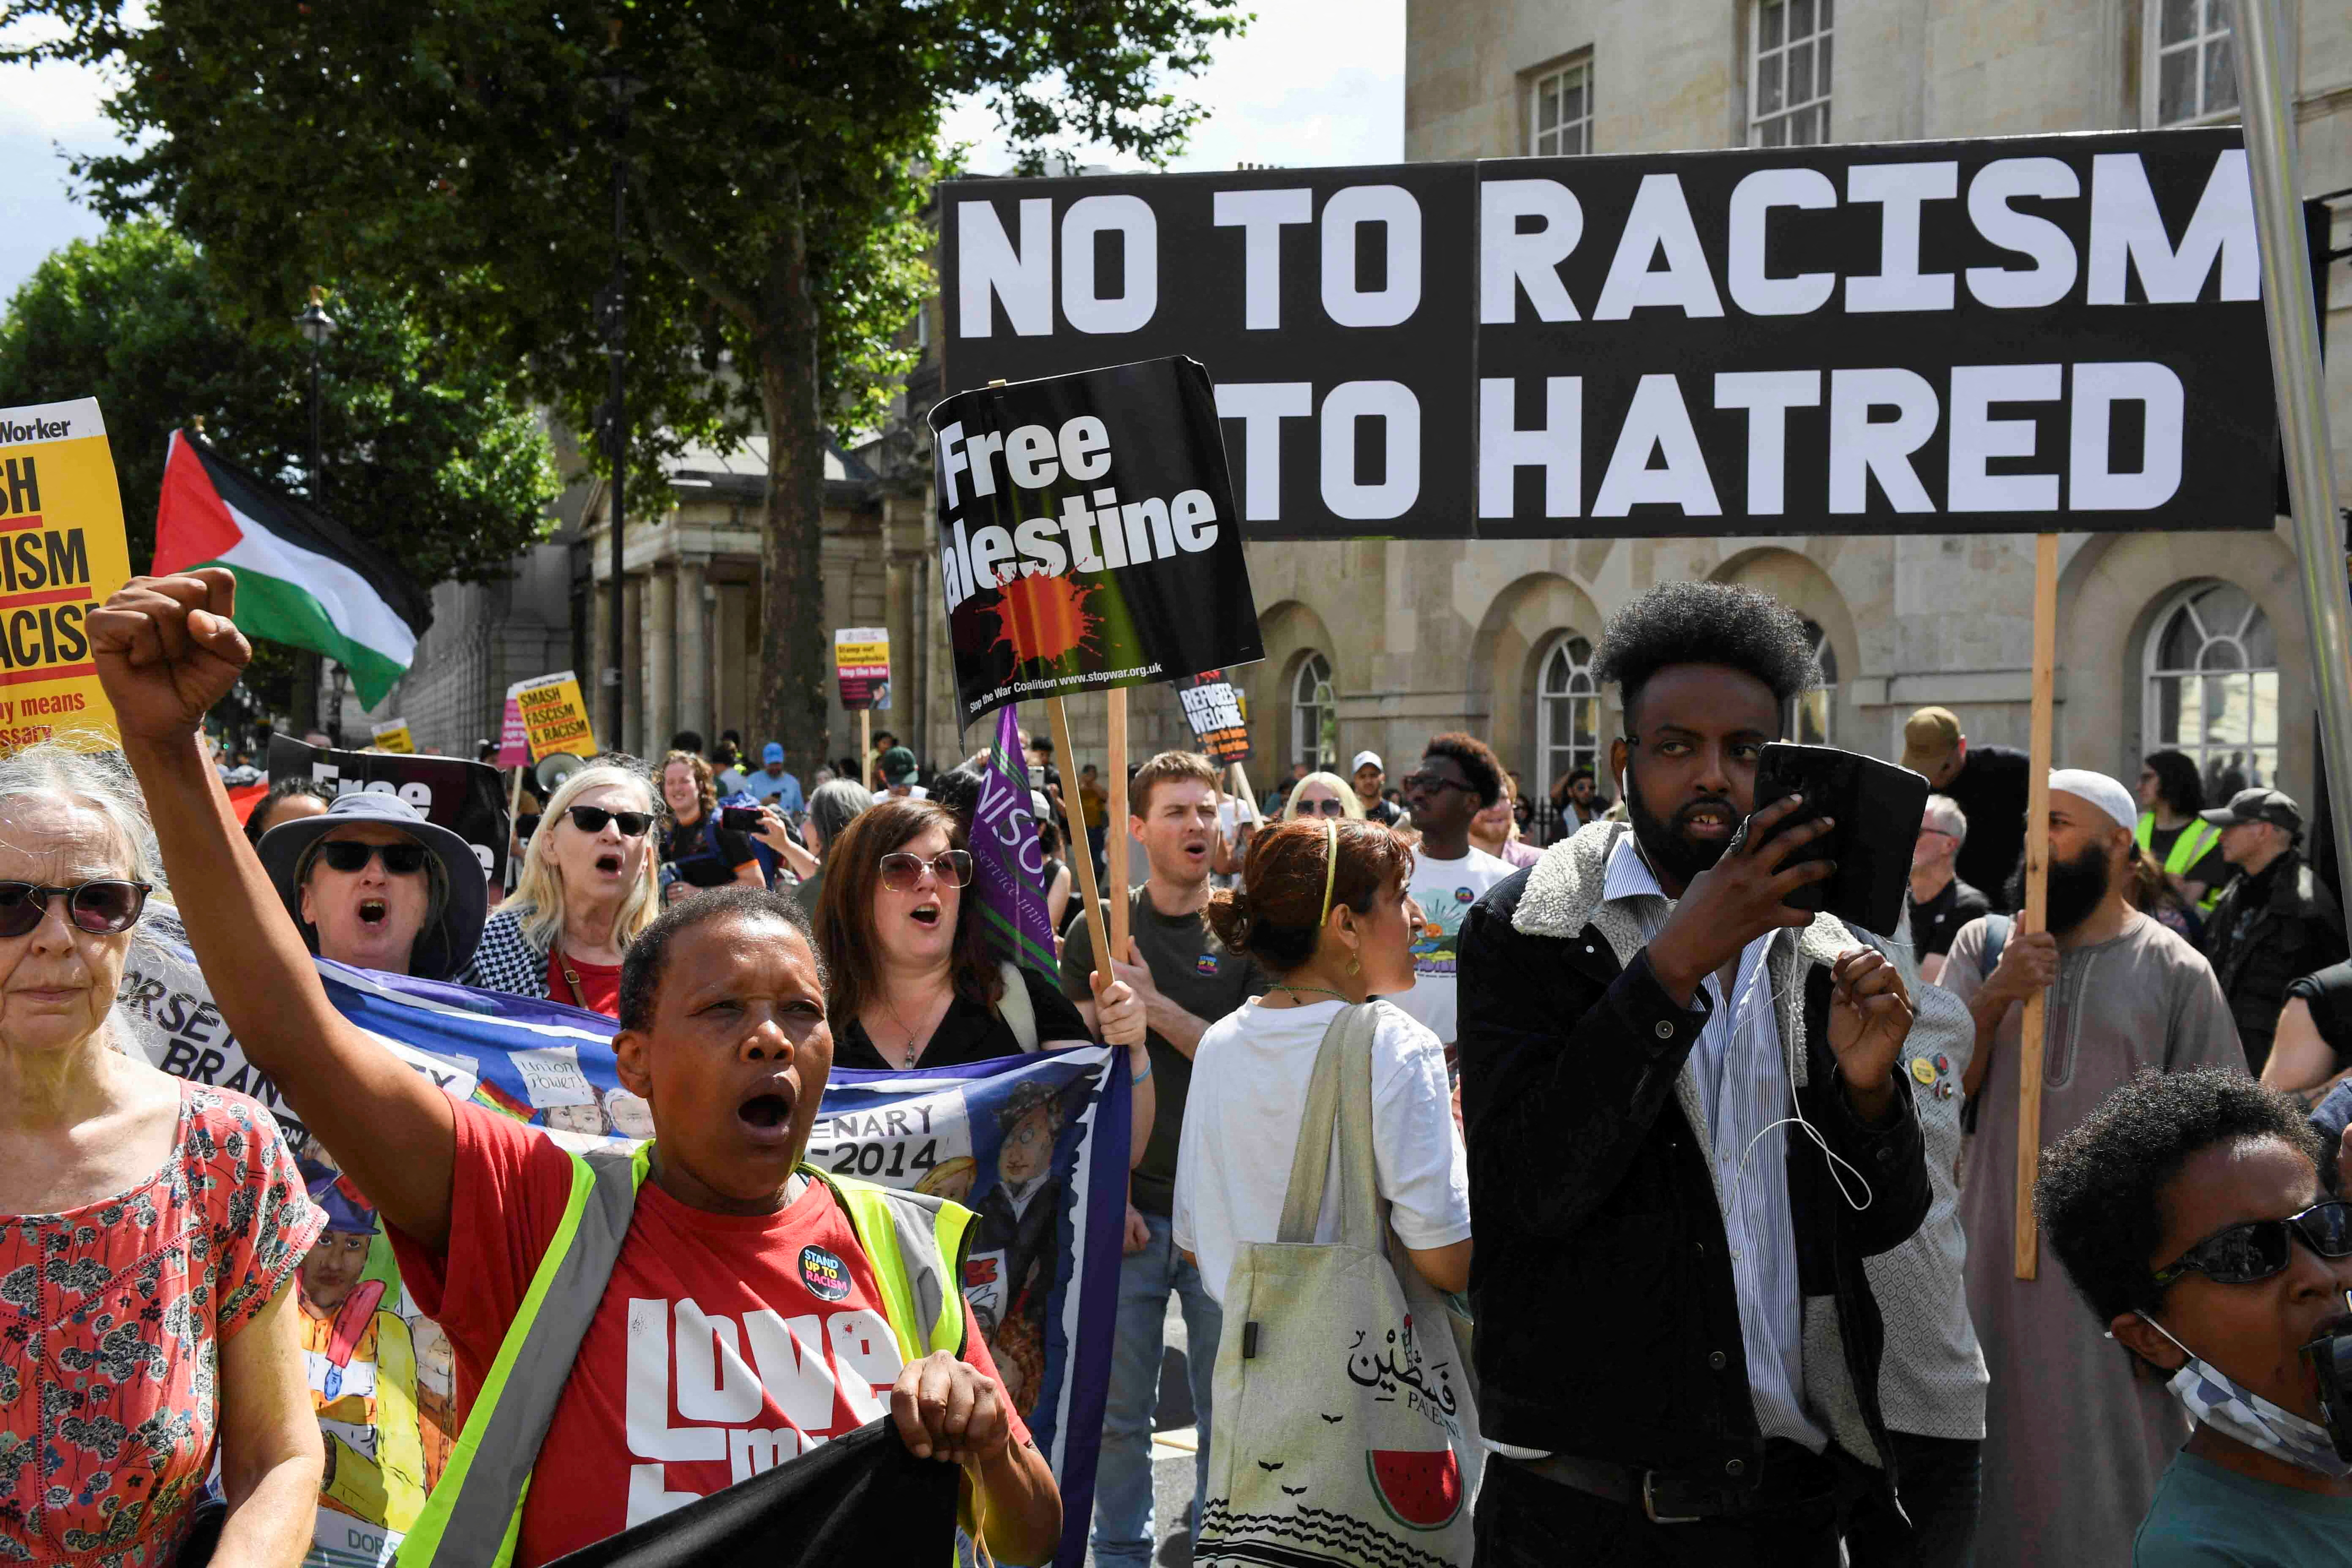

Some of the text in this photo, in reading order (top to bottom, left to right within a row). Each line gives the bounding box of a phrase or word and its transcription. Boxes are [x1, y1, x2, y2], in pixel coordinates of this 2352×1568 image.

[958, 149, 2261, 338] NO TO RACISM
[1214, 361, 2185, 520] TO HATRED
[939, 415, 1111, 510] Free
[0, 527, 90, 592] ISM
[520, 687, 561, 707] SMASH
[970, 662, 1163, 713] Stop the War Coalition www.stopwar.org.uk
[1180, 682, 1237, 713] REFUGEES
[20, 693, 85, 717] means
[525, 702, 576, 727] FASCISM
[532, 730, 541, 744] &
[542, 719, 588, 740] RACISM
[804, 1249, 838, 1269] STAND
[805, 1259, 838, 1279] UP TO
[806, 1270, 848, 1291] RACISM
